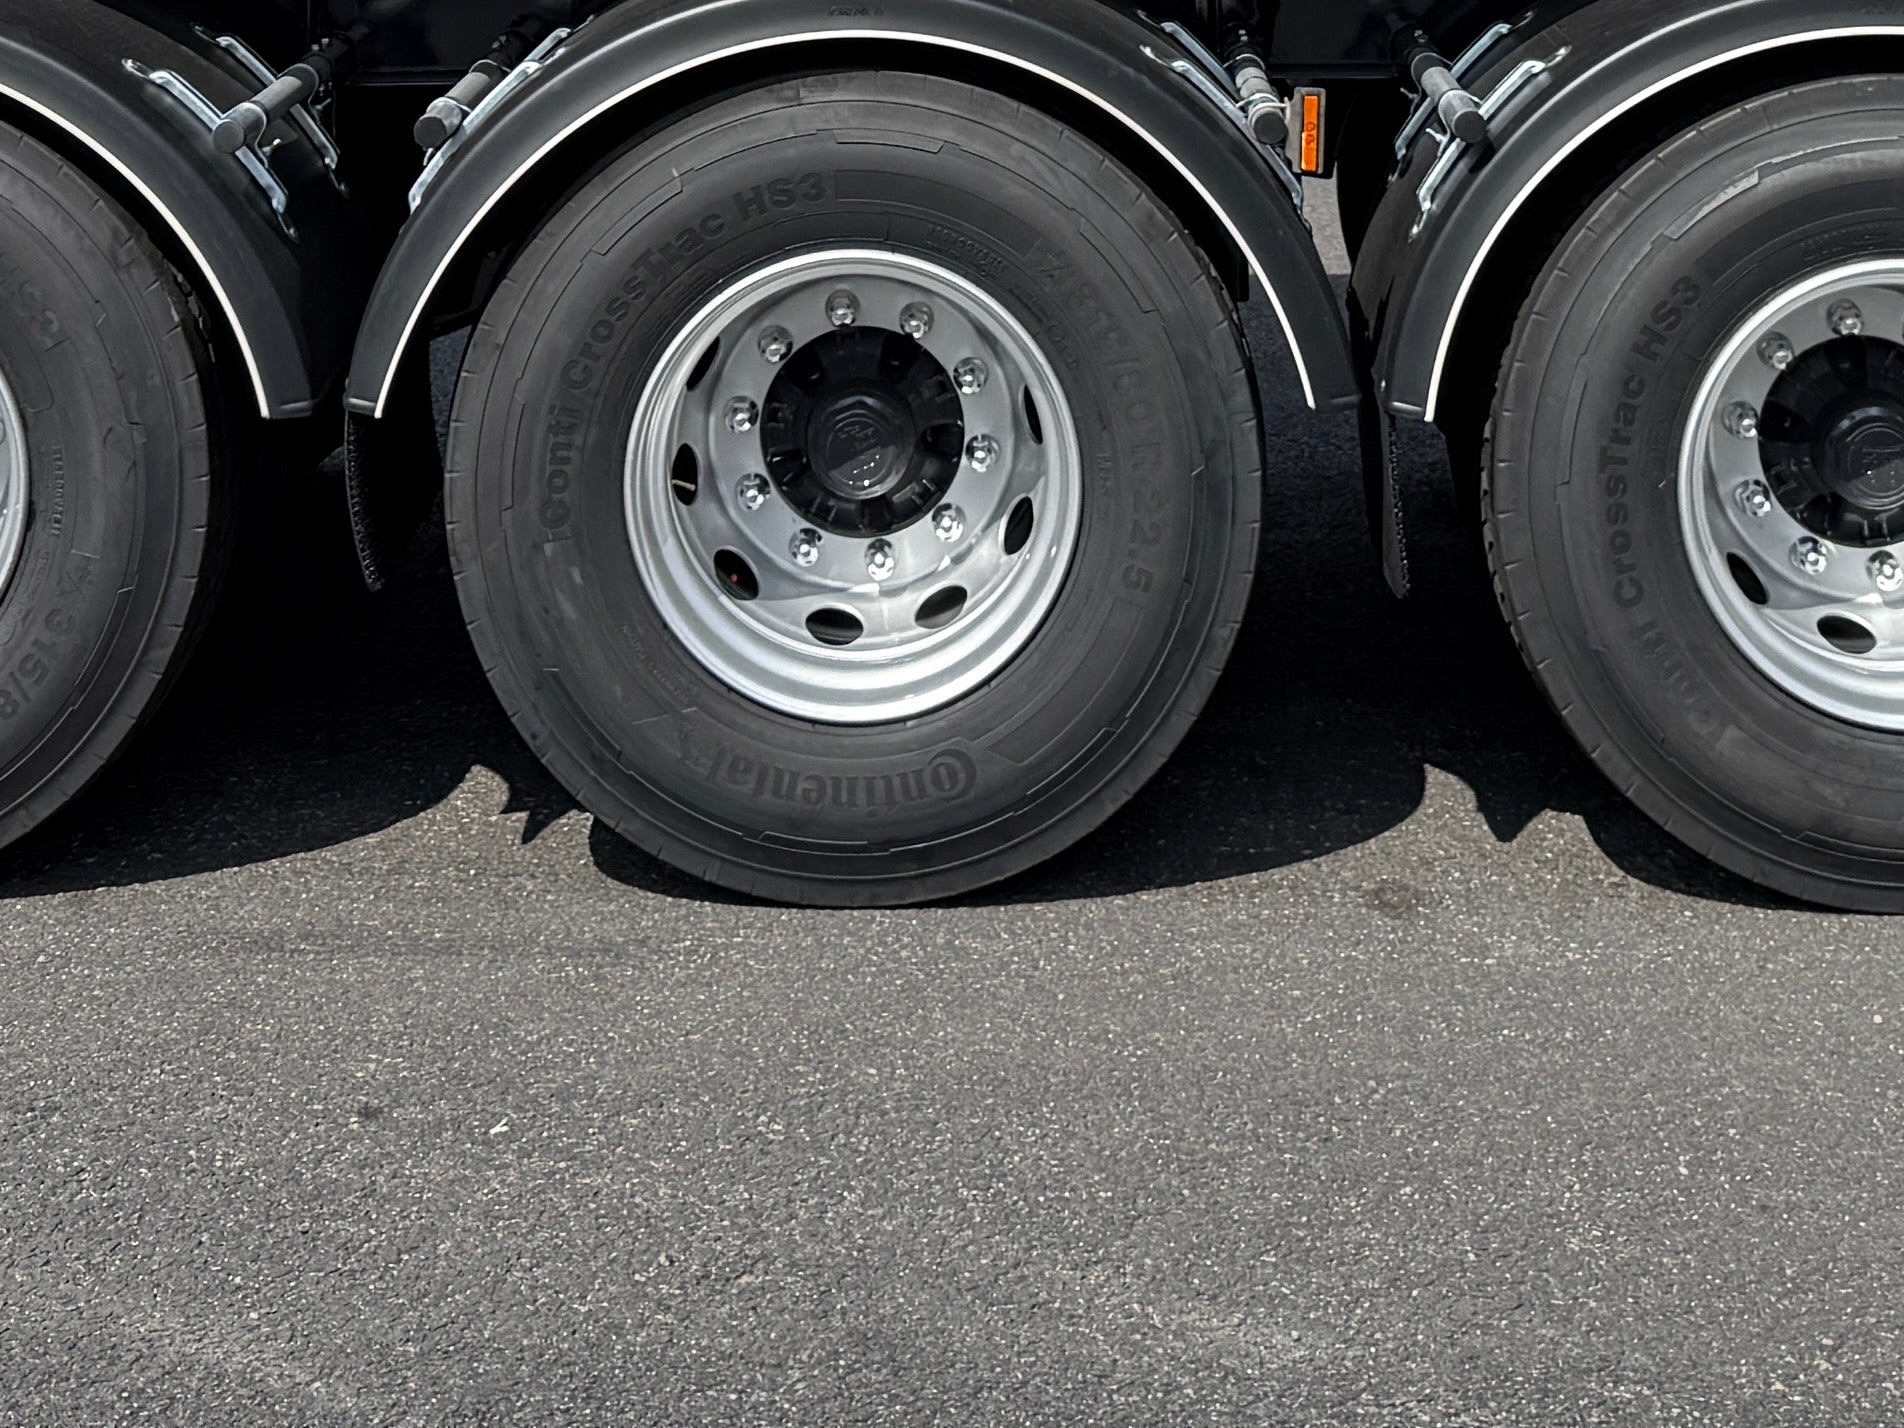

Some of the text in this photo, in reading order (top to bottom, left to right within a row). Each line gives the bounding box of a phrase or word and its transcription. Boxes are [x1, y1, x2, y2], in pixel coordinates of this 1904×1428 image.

[539, 172, 826, 528] Conti CrossTrac HS3
[1601, 374, 1651, 609] CrossTrac
[1635, 275, 1702, 362] HS3
[708, 748, 976, 807] Continental
